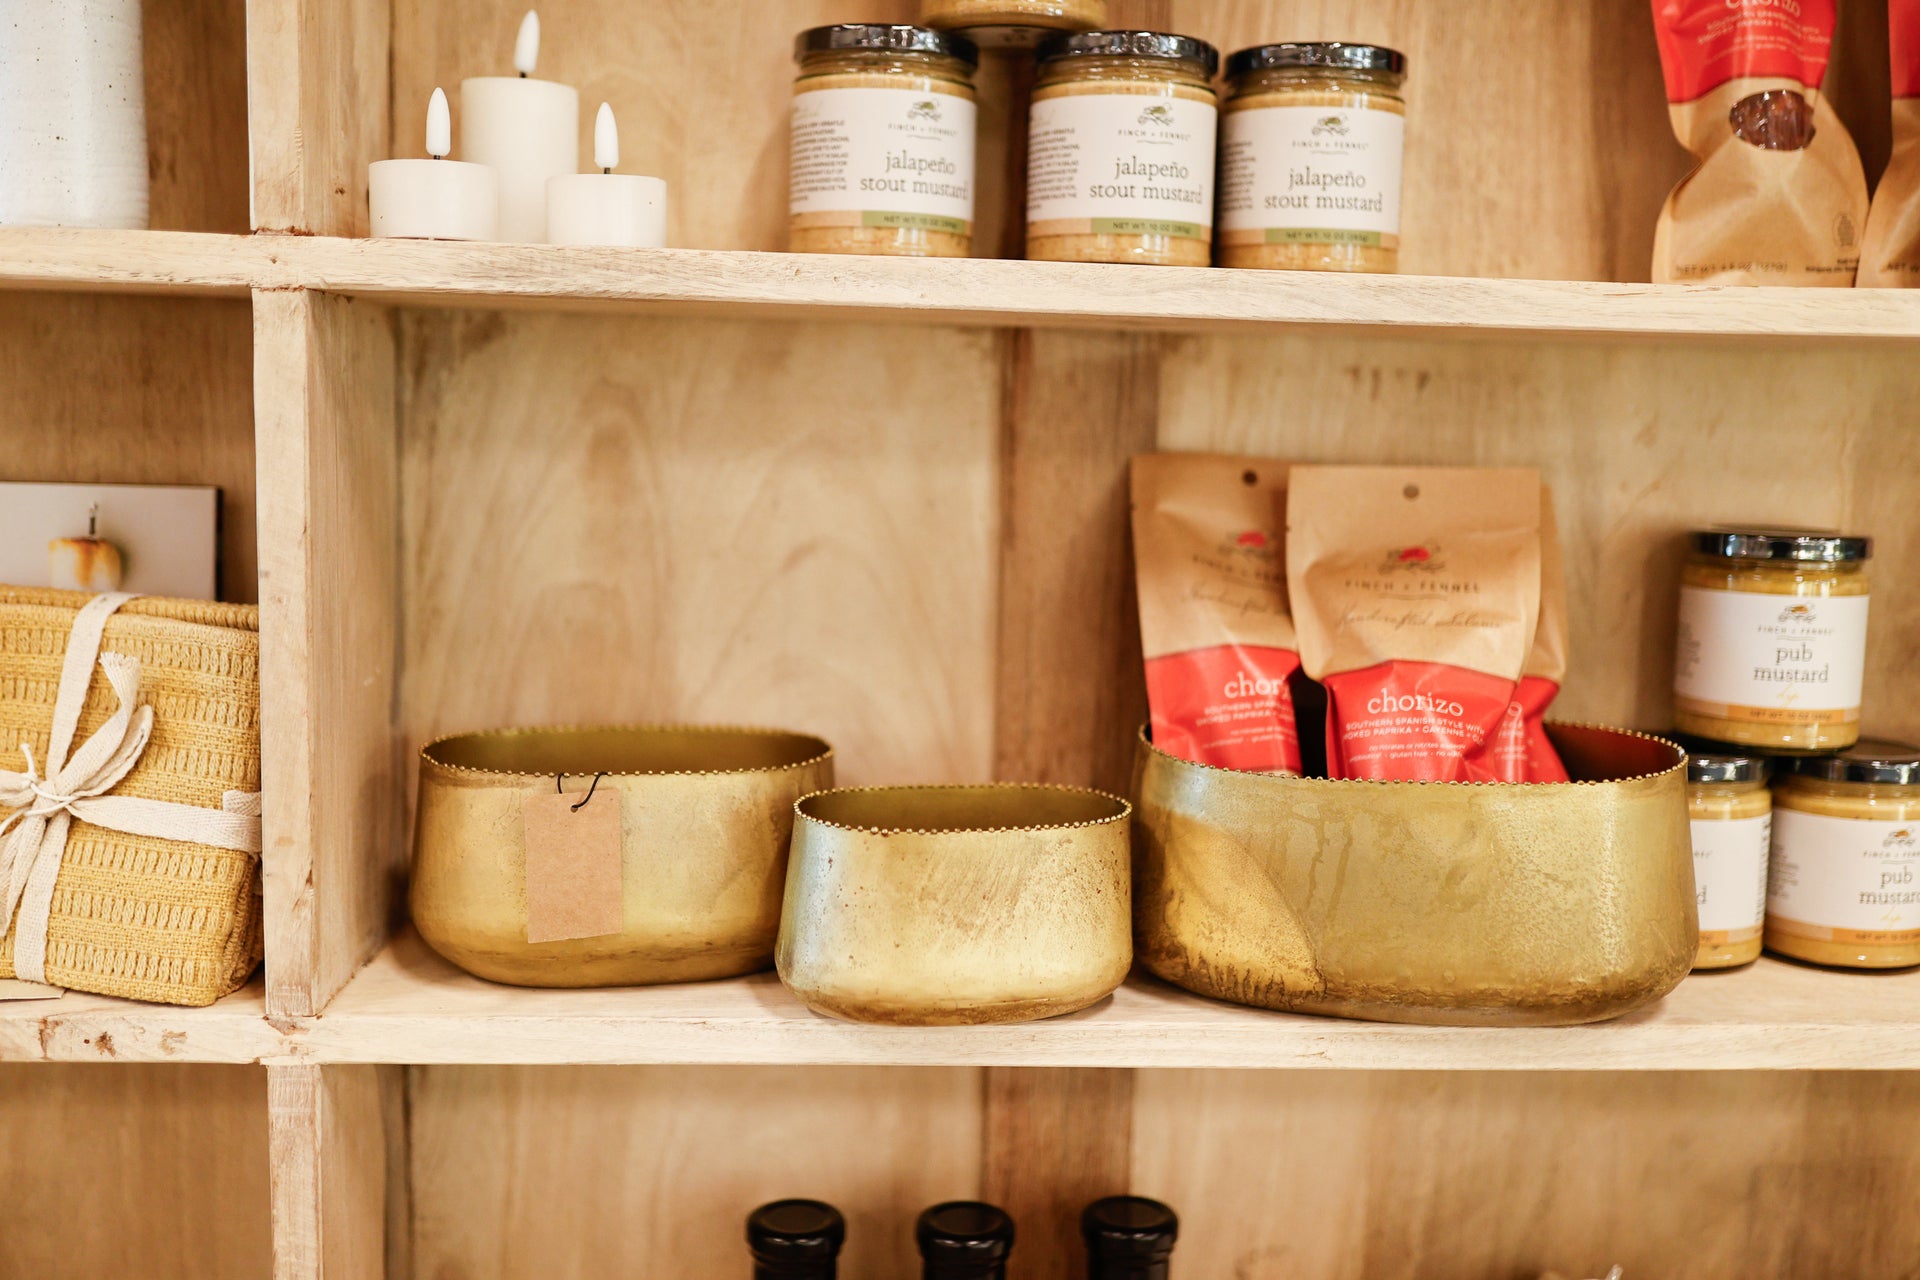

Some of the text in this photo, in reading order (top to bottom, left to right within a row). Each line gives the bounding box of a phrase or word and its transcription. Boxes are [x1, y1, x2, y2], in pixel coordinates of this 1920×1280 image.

[885, 150, 956, 175] jalapeño
[1114, 155, 1189, 181] jalapeño
[860, 177, 969, 200] stout mustard
[1288, 166, 1366, 190] jalapeño
[1089, 184, 1203, 204] stout mustard
[1264, 193, 1382, 212] stout mustard
[1776, 644, 1813, 664] pub
[1753, 664, 1829, 683] mustard
[1367, 688, 1464, 717] chorizo
[1346, 718, 1393, 731] SOUTHERN
[1395, 717, 1436, 727] SPANISH
[1437, 718, 1464, 730] STYLE
[1373, 726, 1412, 737] PAPRIKA
[1422, 725, 1465, 738] CAYENNE
[1880, 865, 1913, 889] pub
